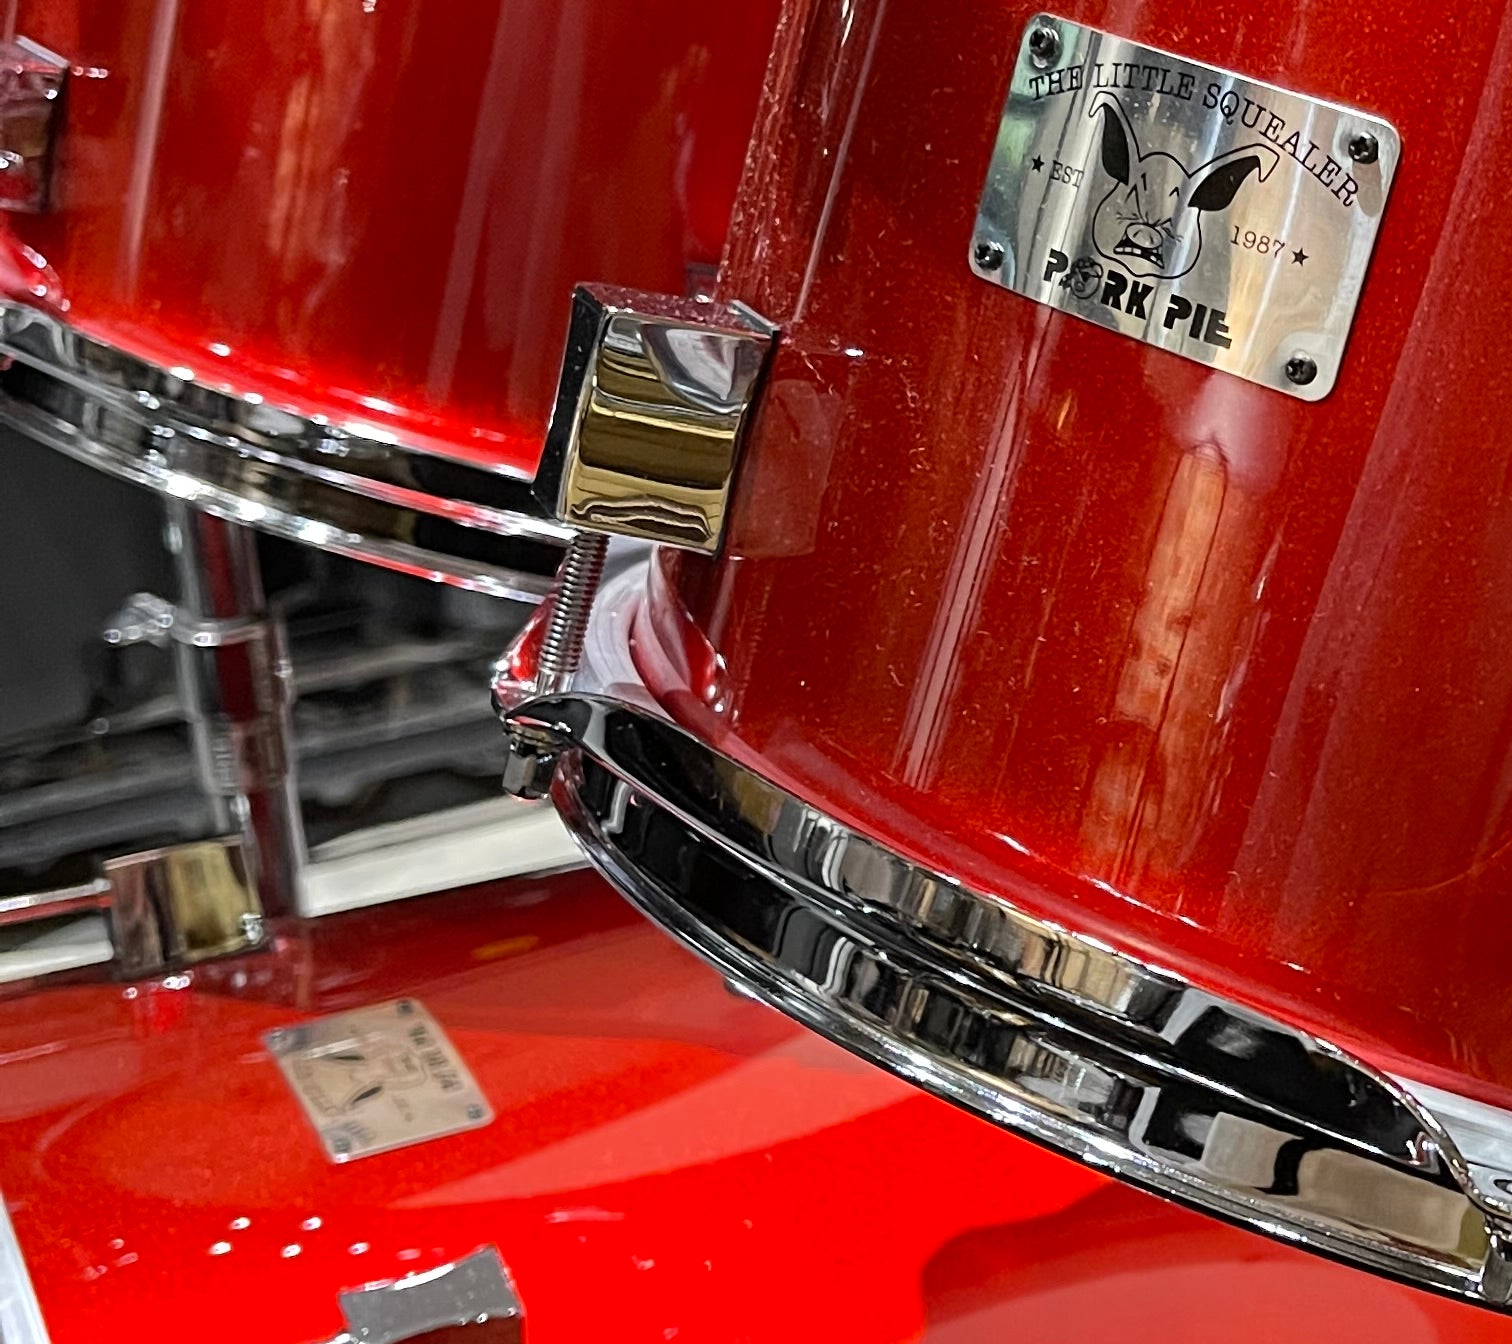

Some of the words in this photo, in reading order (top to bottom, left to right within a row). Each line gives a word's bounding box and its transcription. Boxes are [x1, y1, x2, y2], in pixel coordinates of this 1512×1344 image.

[1029, 64, 1084, 102] THE
[1093, 62, 1196, 102] LITTLE
[1202, 82, 1359, 208] SQUEALER
[1049, 160, 1084, 190] EST
[1229, 225, 1286, 258] 1987
[1163, 294, 1233, 350] PIE
